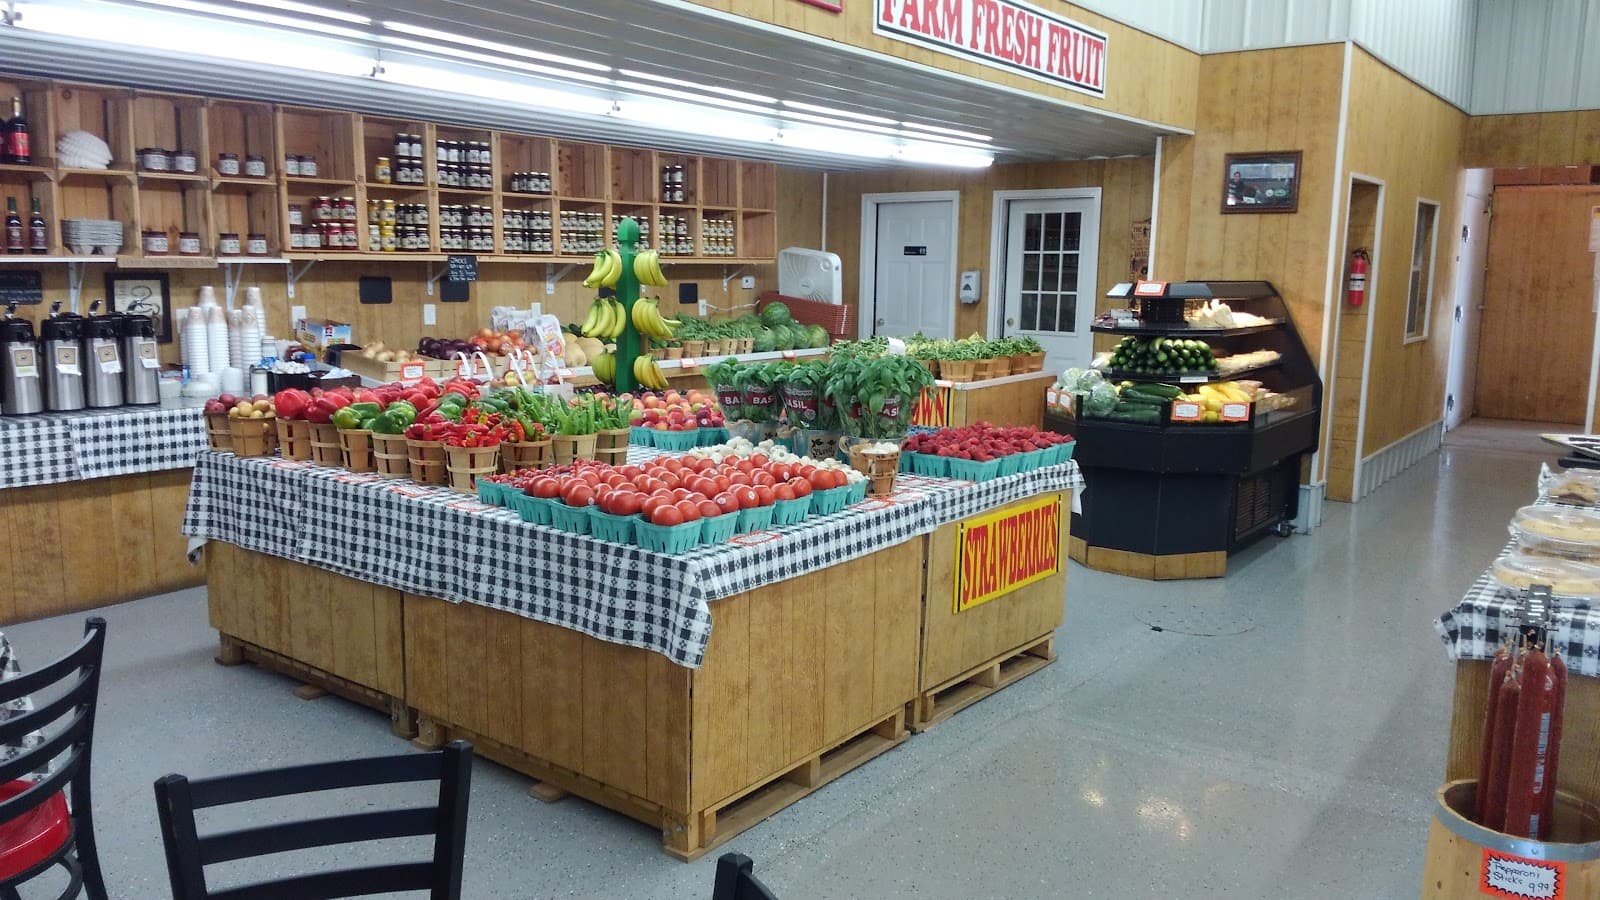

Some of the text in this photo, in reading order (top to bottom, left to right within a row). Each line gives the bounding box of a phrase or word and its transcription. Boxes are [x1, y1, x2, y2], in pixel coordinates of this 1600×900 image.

[970, 0, 1043, 69] FRESH
[1046, 23, 1104, 87] FRUIT
[962, 501, 1057, 606] STRAWBERRIES
